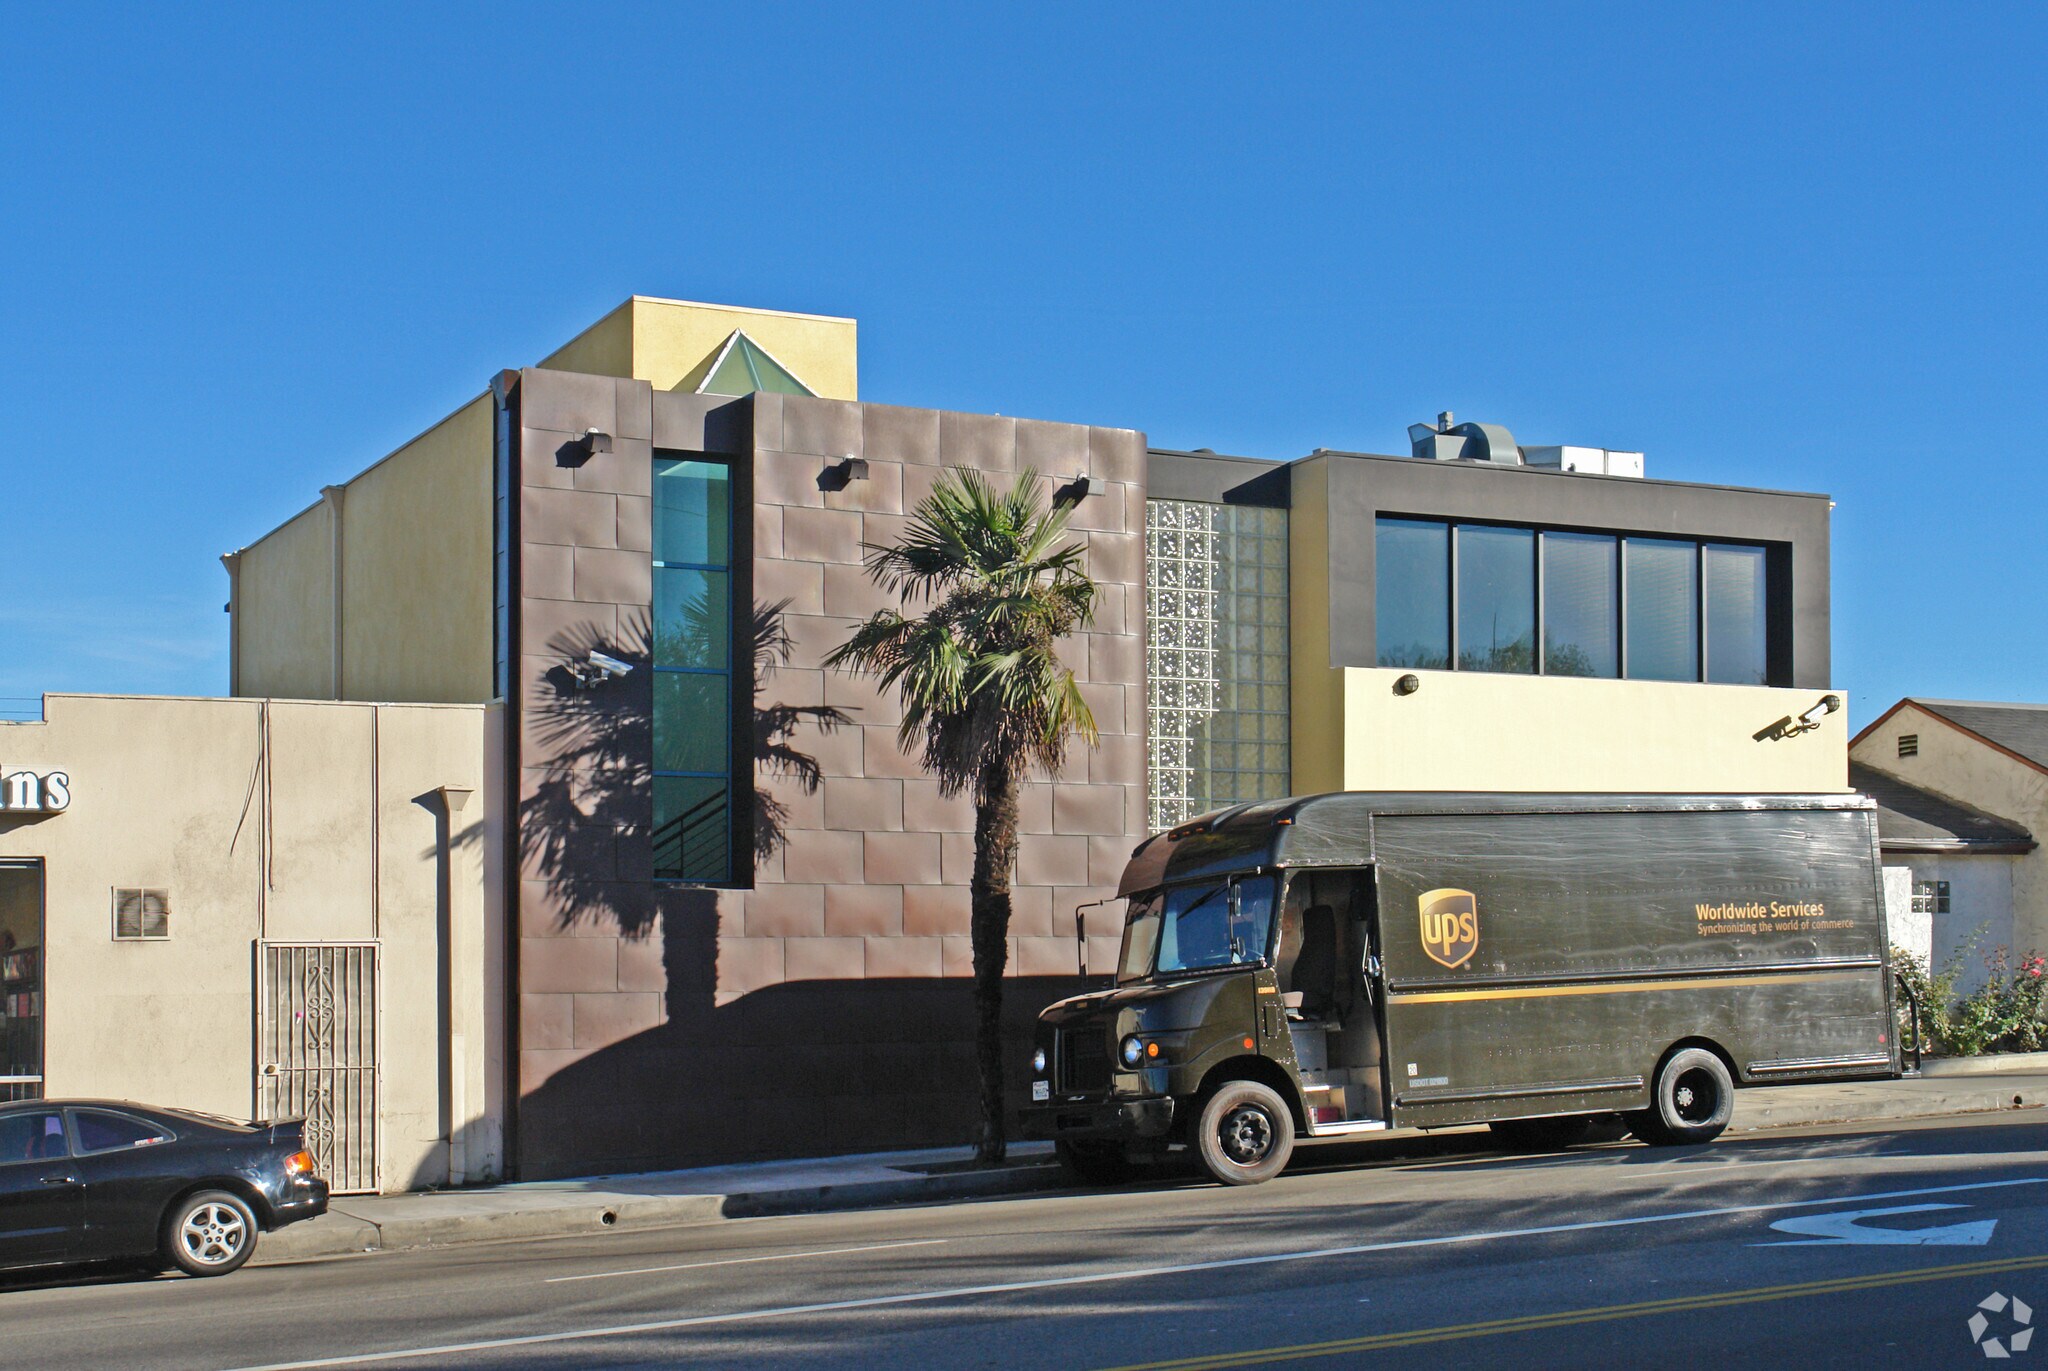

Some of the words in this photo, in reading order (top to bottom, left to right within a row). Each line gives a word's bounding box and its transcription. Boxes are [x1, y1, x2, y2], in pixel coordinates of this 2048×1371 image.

[0, 765, 71, 811] ns
[1695, 902, 1767, 920] Worldwide
[1770, 900, 1824, 918] Services
[1424, 912, 1474, 956] ups
[1697, 922, 1757, 937] Synchronizing
[1759, 921, 1773, 932] the
[1775, 920, 1799, 931] world
[1801, 920, 1810, 930] of
[1812, 919, 1854, 930] commerce
